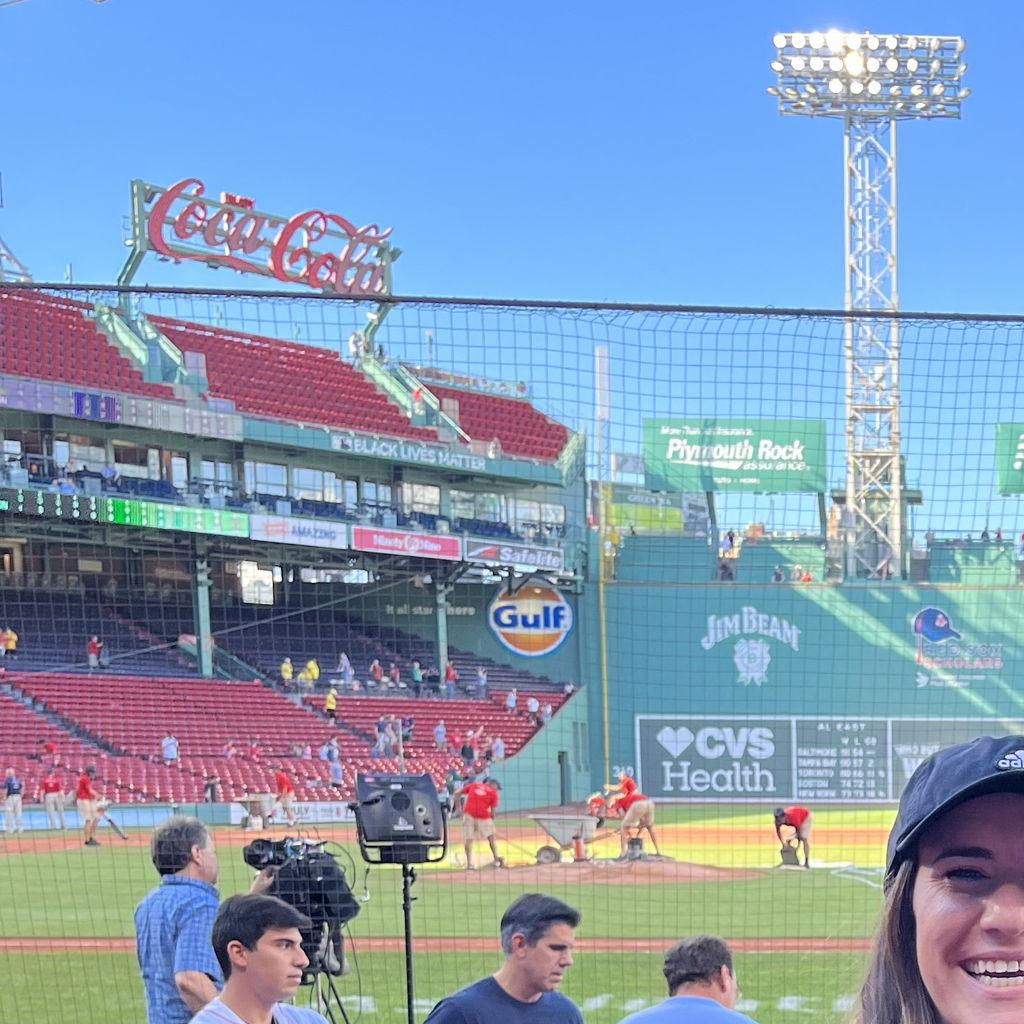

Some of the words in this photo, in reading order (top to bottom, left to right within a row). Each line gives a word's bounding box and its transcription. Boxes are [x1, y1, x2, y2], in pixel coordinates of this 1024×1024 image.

[148, 178, 392, 293] Coca-Cola
[352, 440, 398, 458] BLACK
[400, 444, 437, 464] LIVES
[438, 452, 486, 471] MATTER
[666, 438, 753, 465] Plymouth
[758, 439, 804, 461] Rock
[494, 605, 567, 628] Gulf
[700, 613, 741, 651] JIM
[742, 605, 802, 652] BEAM
[695, 726, 776, 760] CVS
[662, 761, 776, 792] Health
